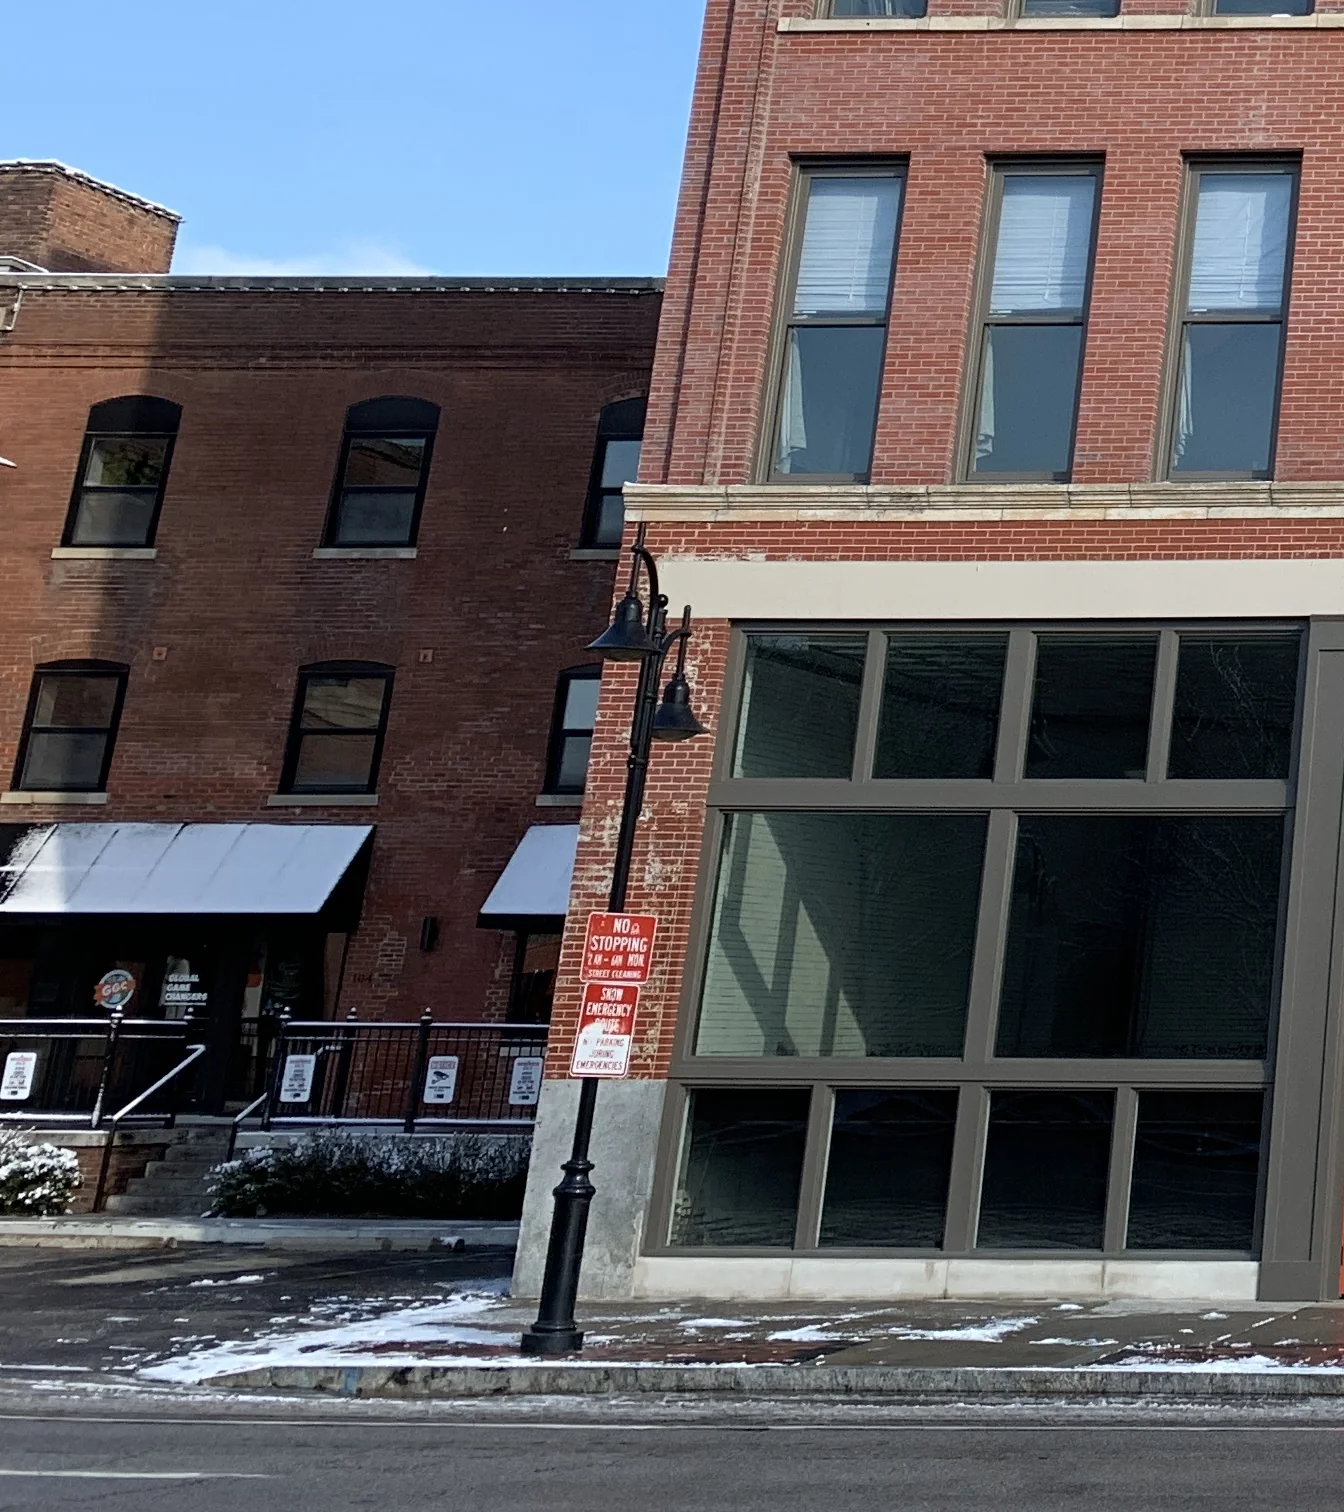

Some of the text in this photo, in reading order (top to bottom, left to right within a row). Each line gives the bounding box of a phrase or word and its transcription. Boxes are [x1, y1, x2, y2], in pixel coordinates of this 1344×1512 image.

[613, 918, 631, 934] NO
[590, 935, 648, 953] STOPPING
[588, 969, 642, 979] STREET CLEANING
[600, 988, 624, 1001] SNOW
[586, 1001, 632, 1017] EMERGENCY
[596, 1038, 624, 1047] PARKING
[576, 1060, 623, 1070] EMERGENCIES
